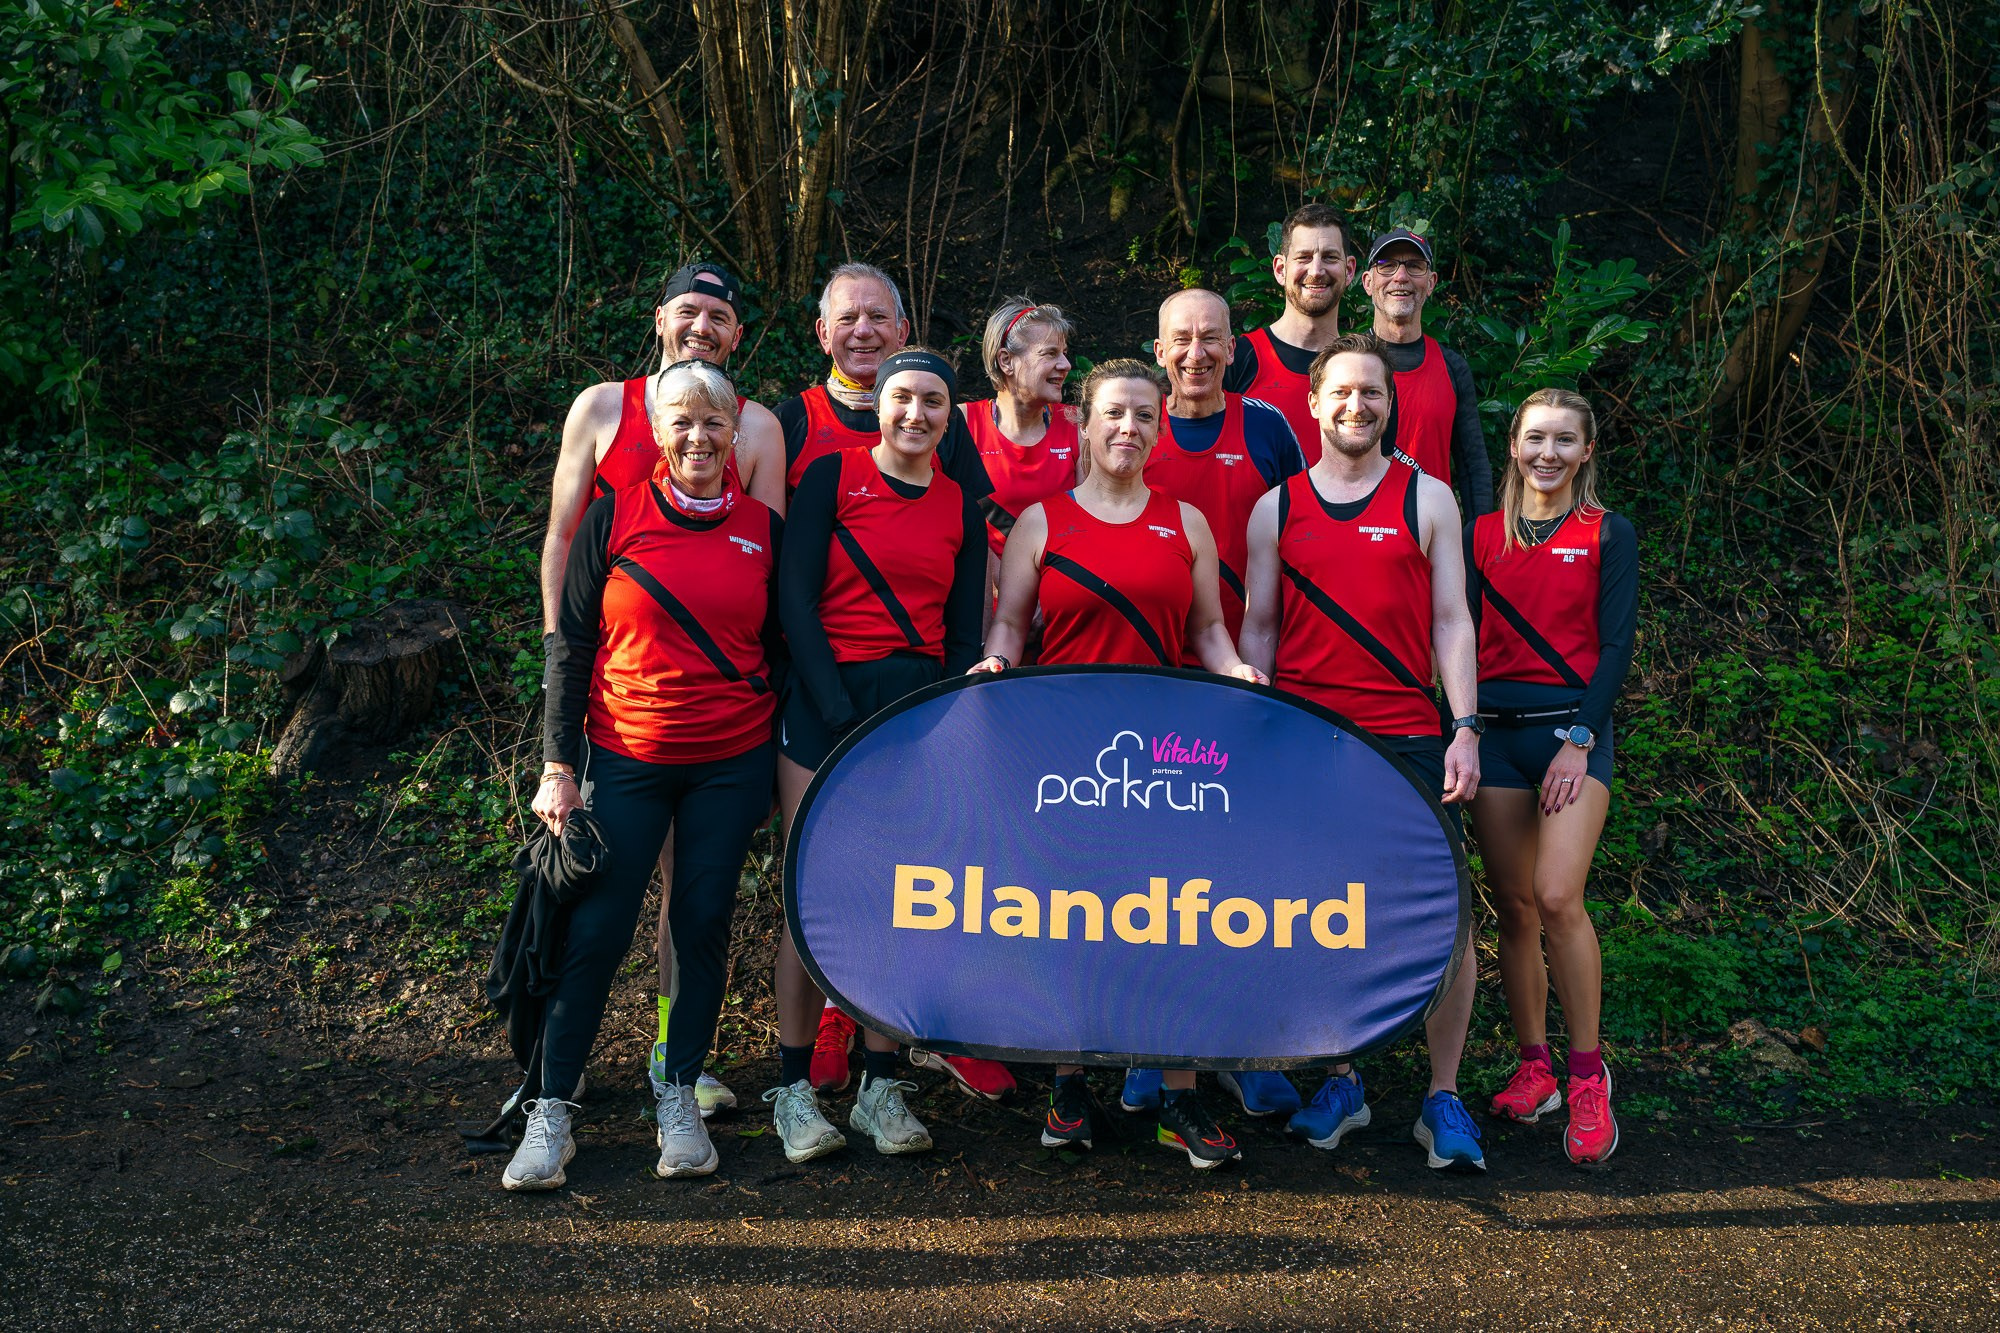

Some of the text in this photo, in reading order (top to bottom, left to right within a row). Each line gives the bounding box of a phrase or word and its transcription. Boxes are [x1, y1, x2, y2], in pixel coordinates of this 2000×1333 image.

[1358, 525, 1398, 536] WIMBORNE
[1370, 533, 1384, 542] AC
[729, 535, 763, 553] WIMBORNE
[742, 545, 753, 555] AC
[1551, 547, 1589, 556] WIMBORNE
[1562, 554, 1575, 563] AC
[1152, 731, 1229, 775] Vitality
[1034, 730, 1230, 813] parkrun
[1152, 767, 1183, 776] partners
[892, 864, 1367, 950] Blandford
